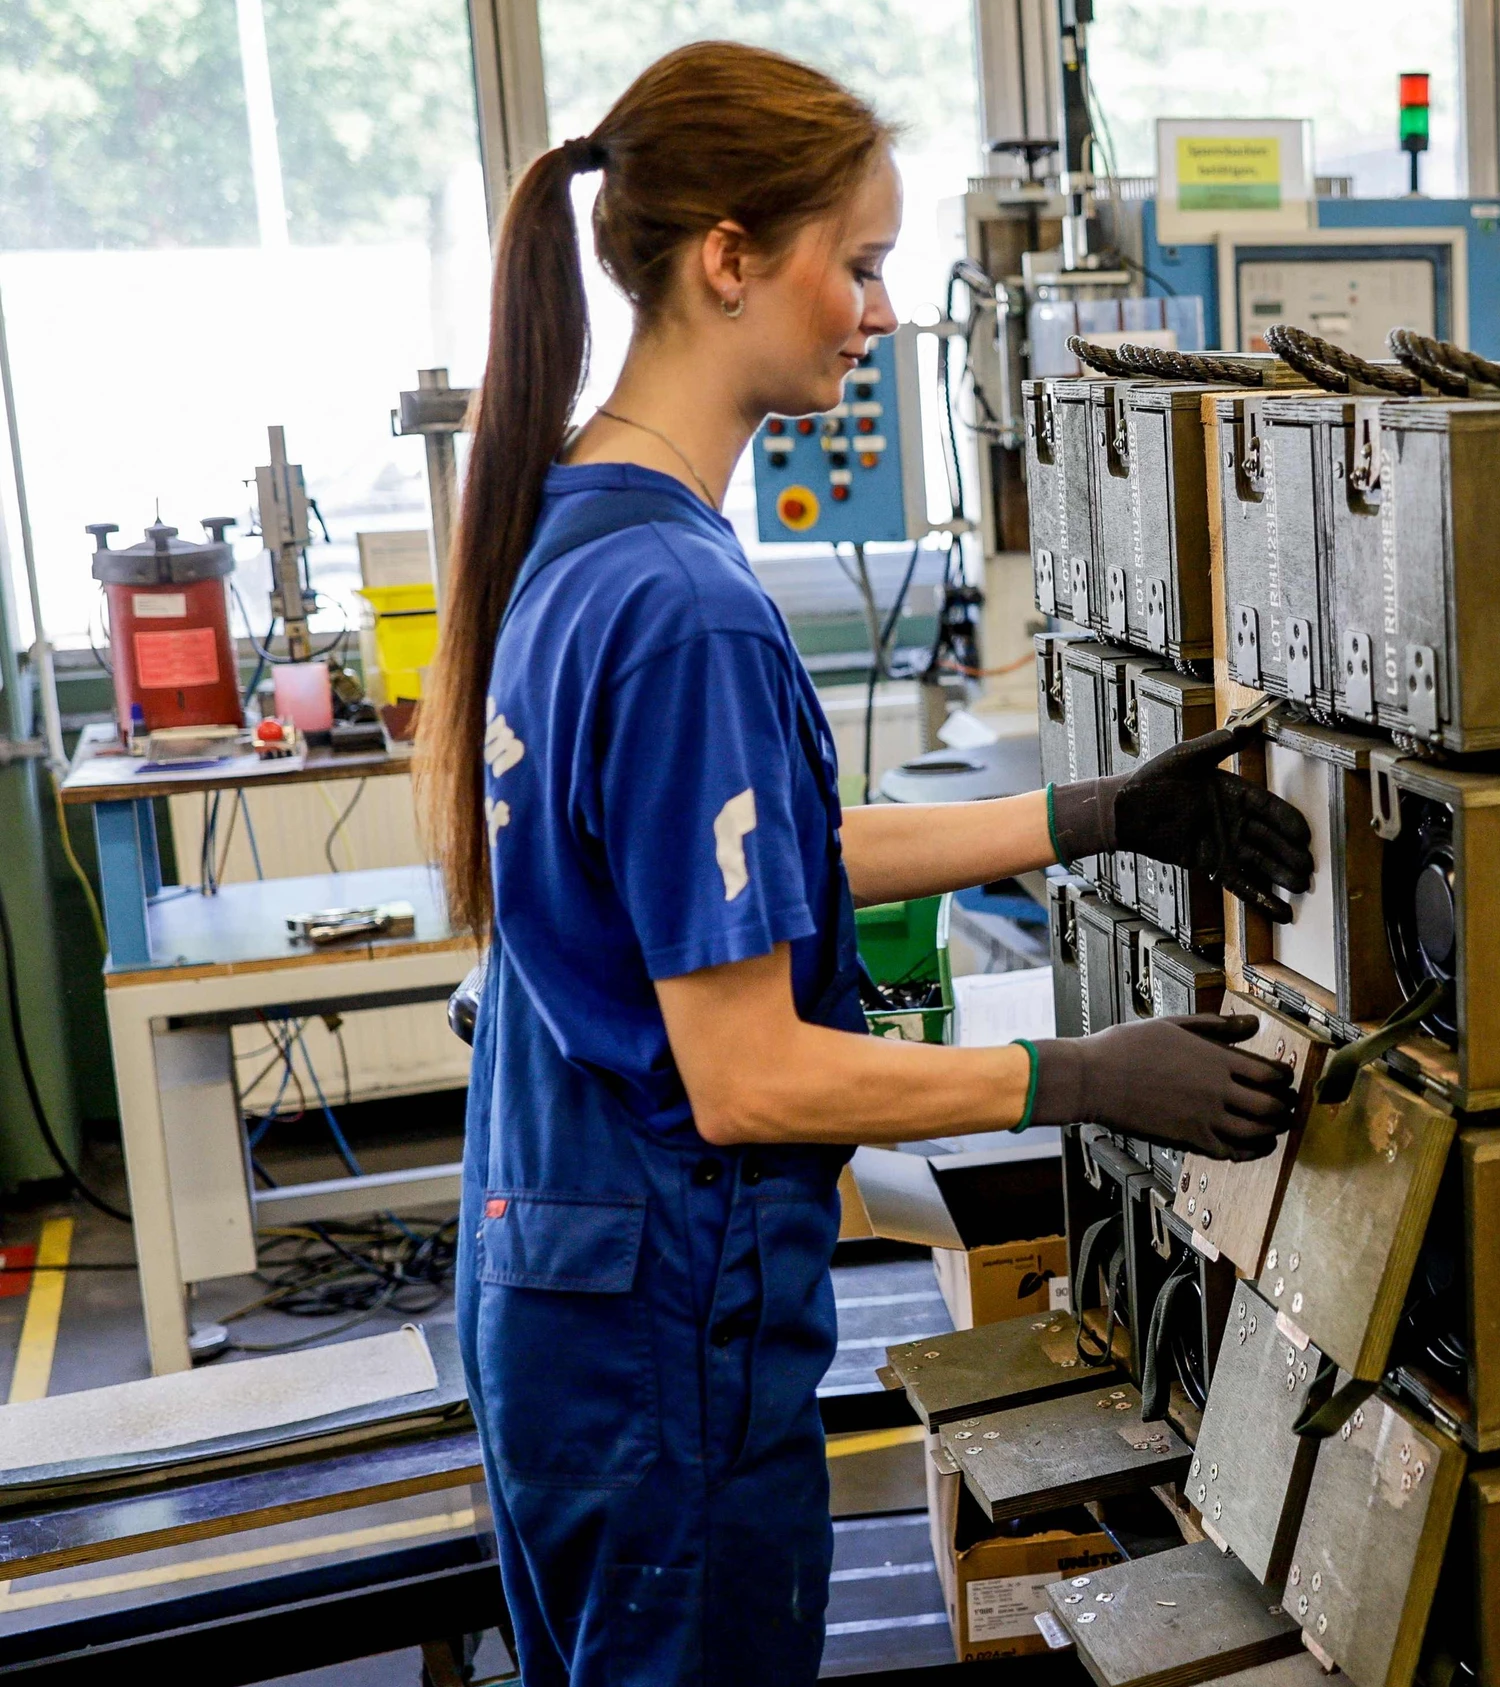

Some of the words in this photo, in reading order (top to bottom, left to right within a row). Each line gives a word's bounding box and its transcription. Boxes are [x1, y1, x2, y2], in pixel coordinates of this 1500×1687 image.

[1263, 438, 1281, 607] RHU23E3302
[1380, 448, 1399, 635] RHU23E3302
[1135, 574, 1145, 616] LOT
[1271, 614, 1282, 661] LOT
[1385, 641, 1399, 695] LOT
